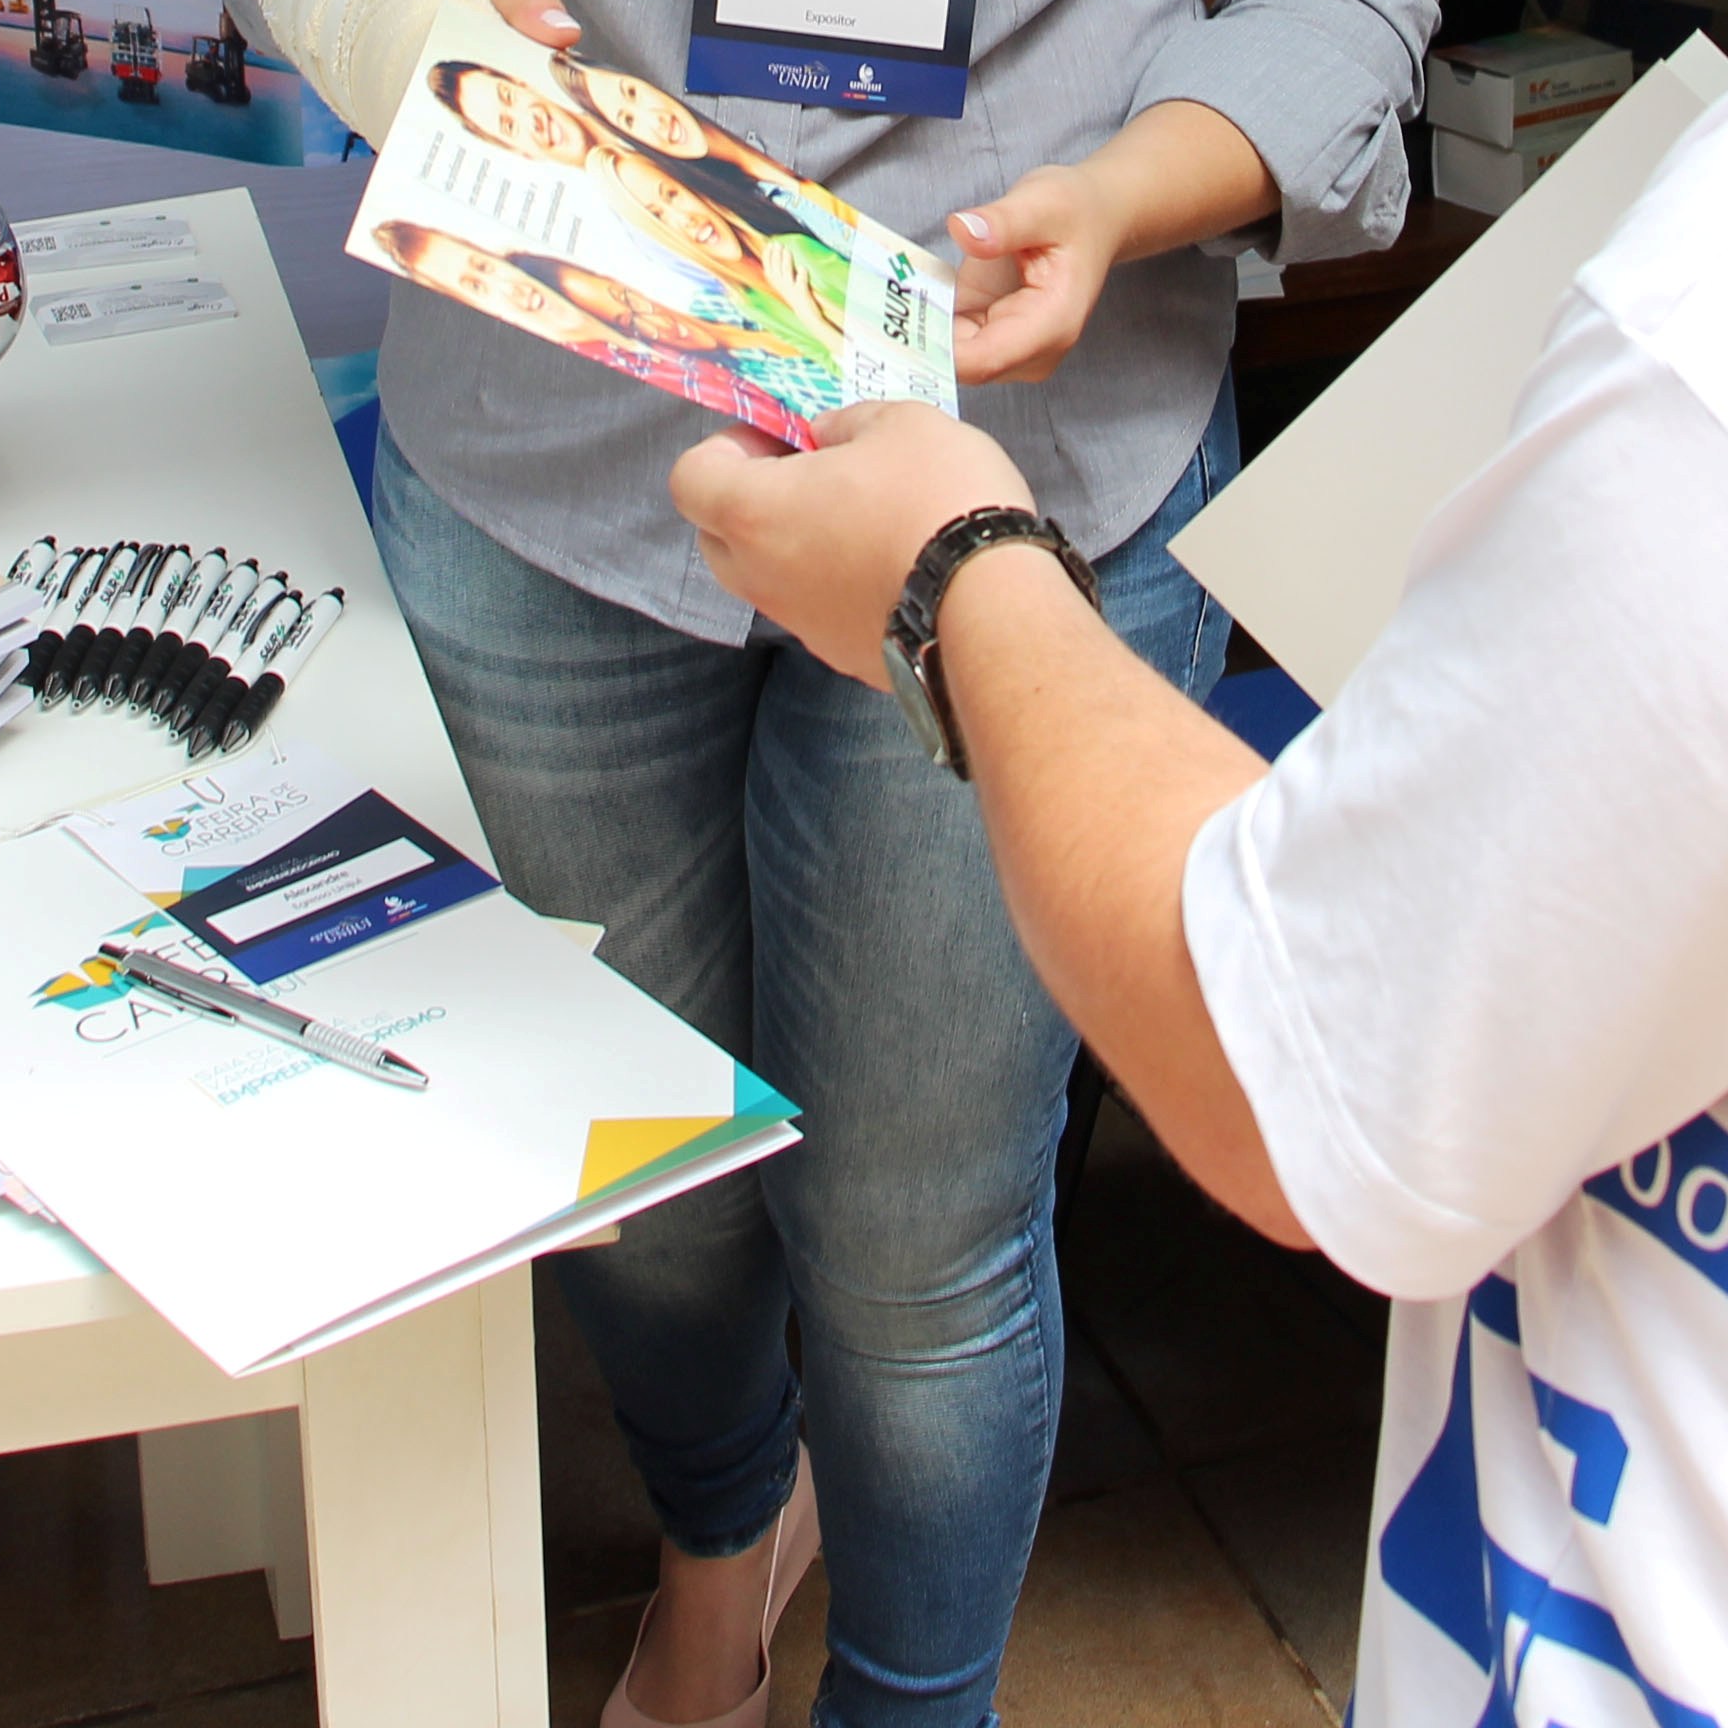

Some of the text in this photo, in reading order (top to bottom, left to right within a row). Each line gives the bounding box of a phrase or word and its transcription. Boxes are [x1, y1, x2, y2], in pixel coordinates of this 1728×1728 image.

[804, 9, 857, 28] Expositor
[883, 277, 912, 347] SAUR
[160, 790, 310, 858] CARREIRAS
[196, 781, 295, 831] FEIRA DE
